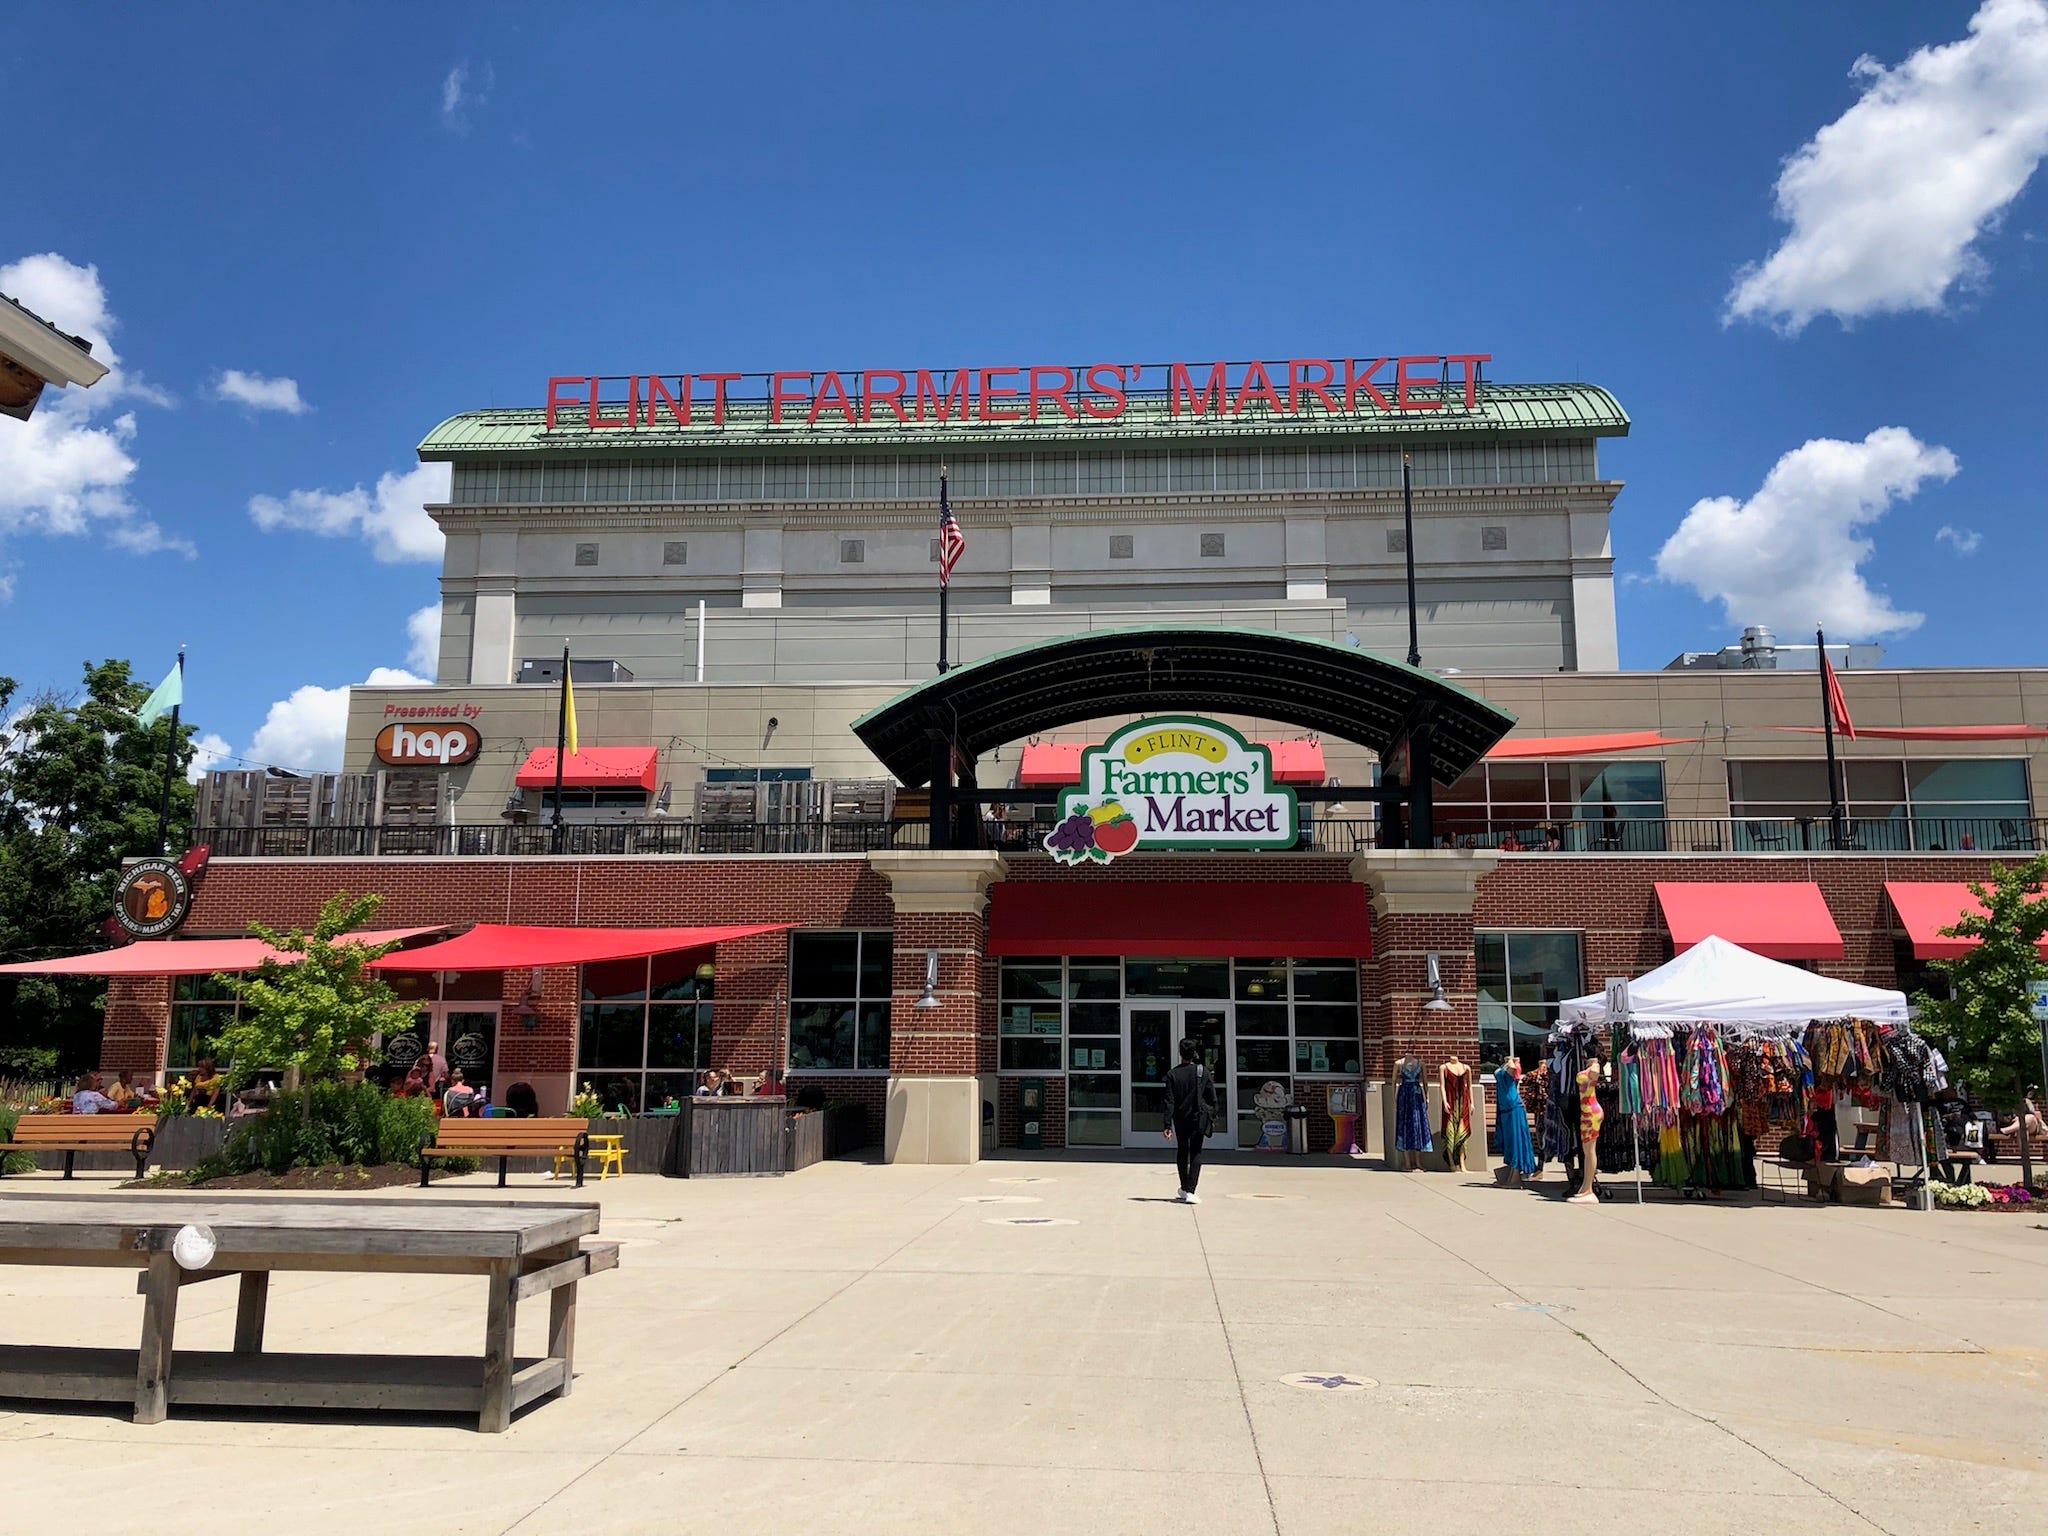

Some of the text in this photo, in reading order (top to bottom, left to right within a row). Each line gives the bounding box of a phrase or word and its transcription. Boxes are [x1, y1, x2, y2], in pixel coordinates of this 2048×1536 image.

[546, 353, 1492, 429] FLINT FARMERS' MARKET
[384, 703, 482, 719] Presented by
[392, 724, 467, 764] hap
[1147, 733, 1207, 751] FLINT
[1100, 759, 1259, 795] Farmers'
[1144, 794, 1279, 832] Market
[117, 863, 184, 894] MICHIGAN BEER
[115, 902, 183, 933] UPSTAIRS MARKET TAP
